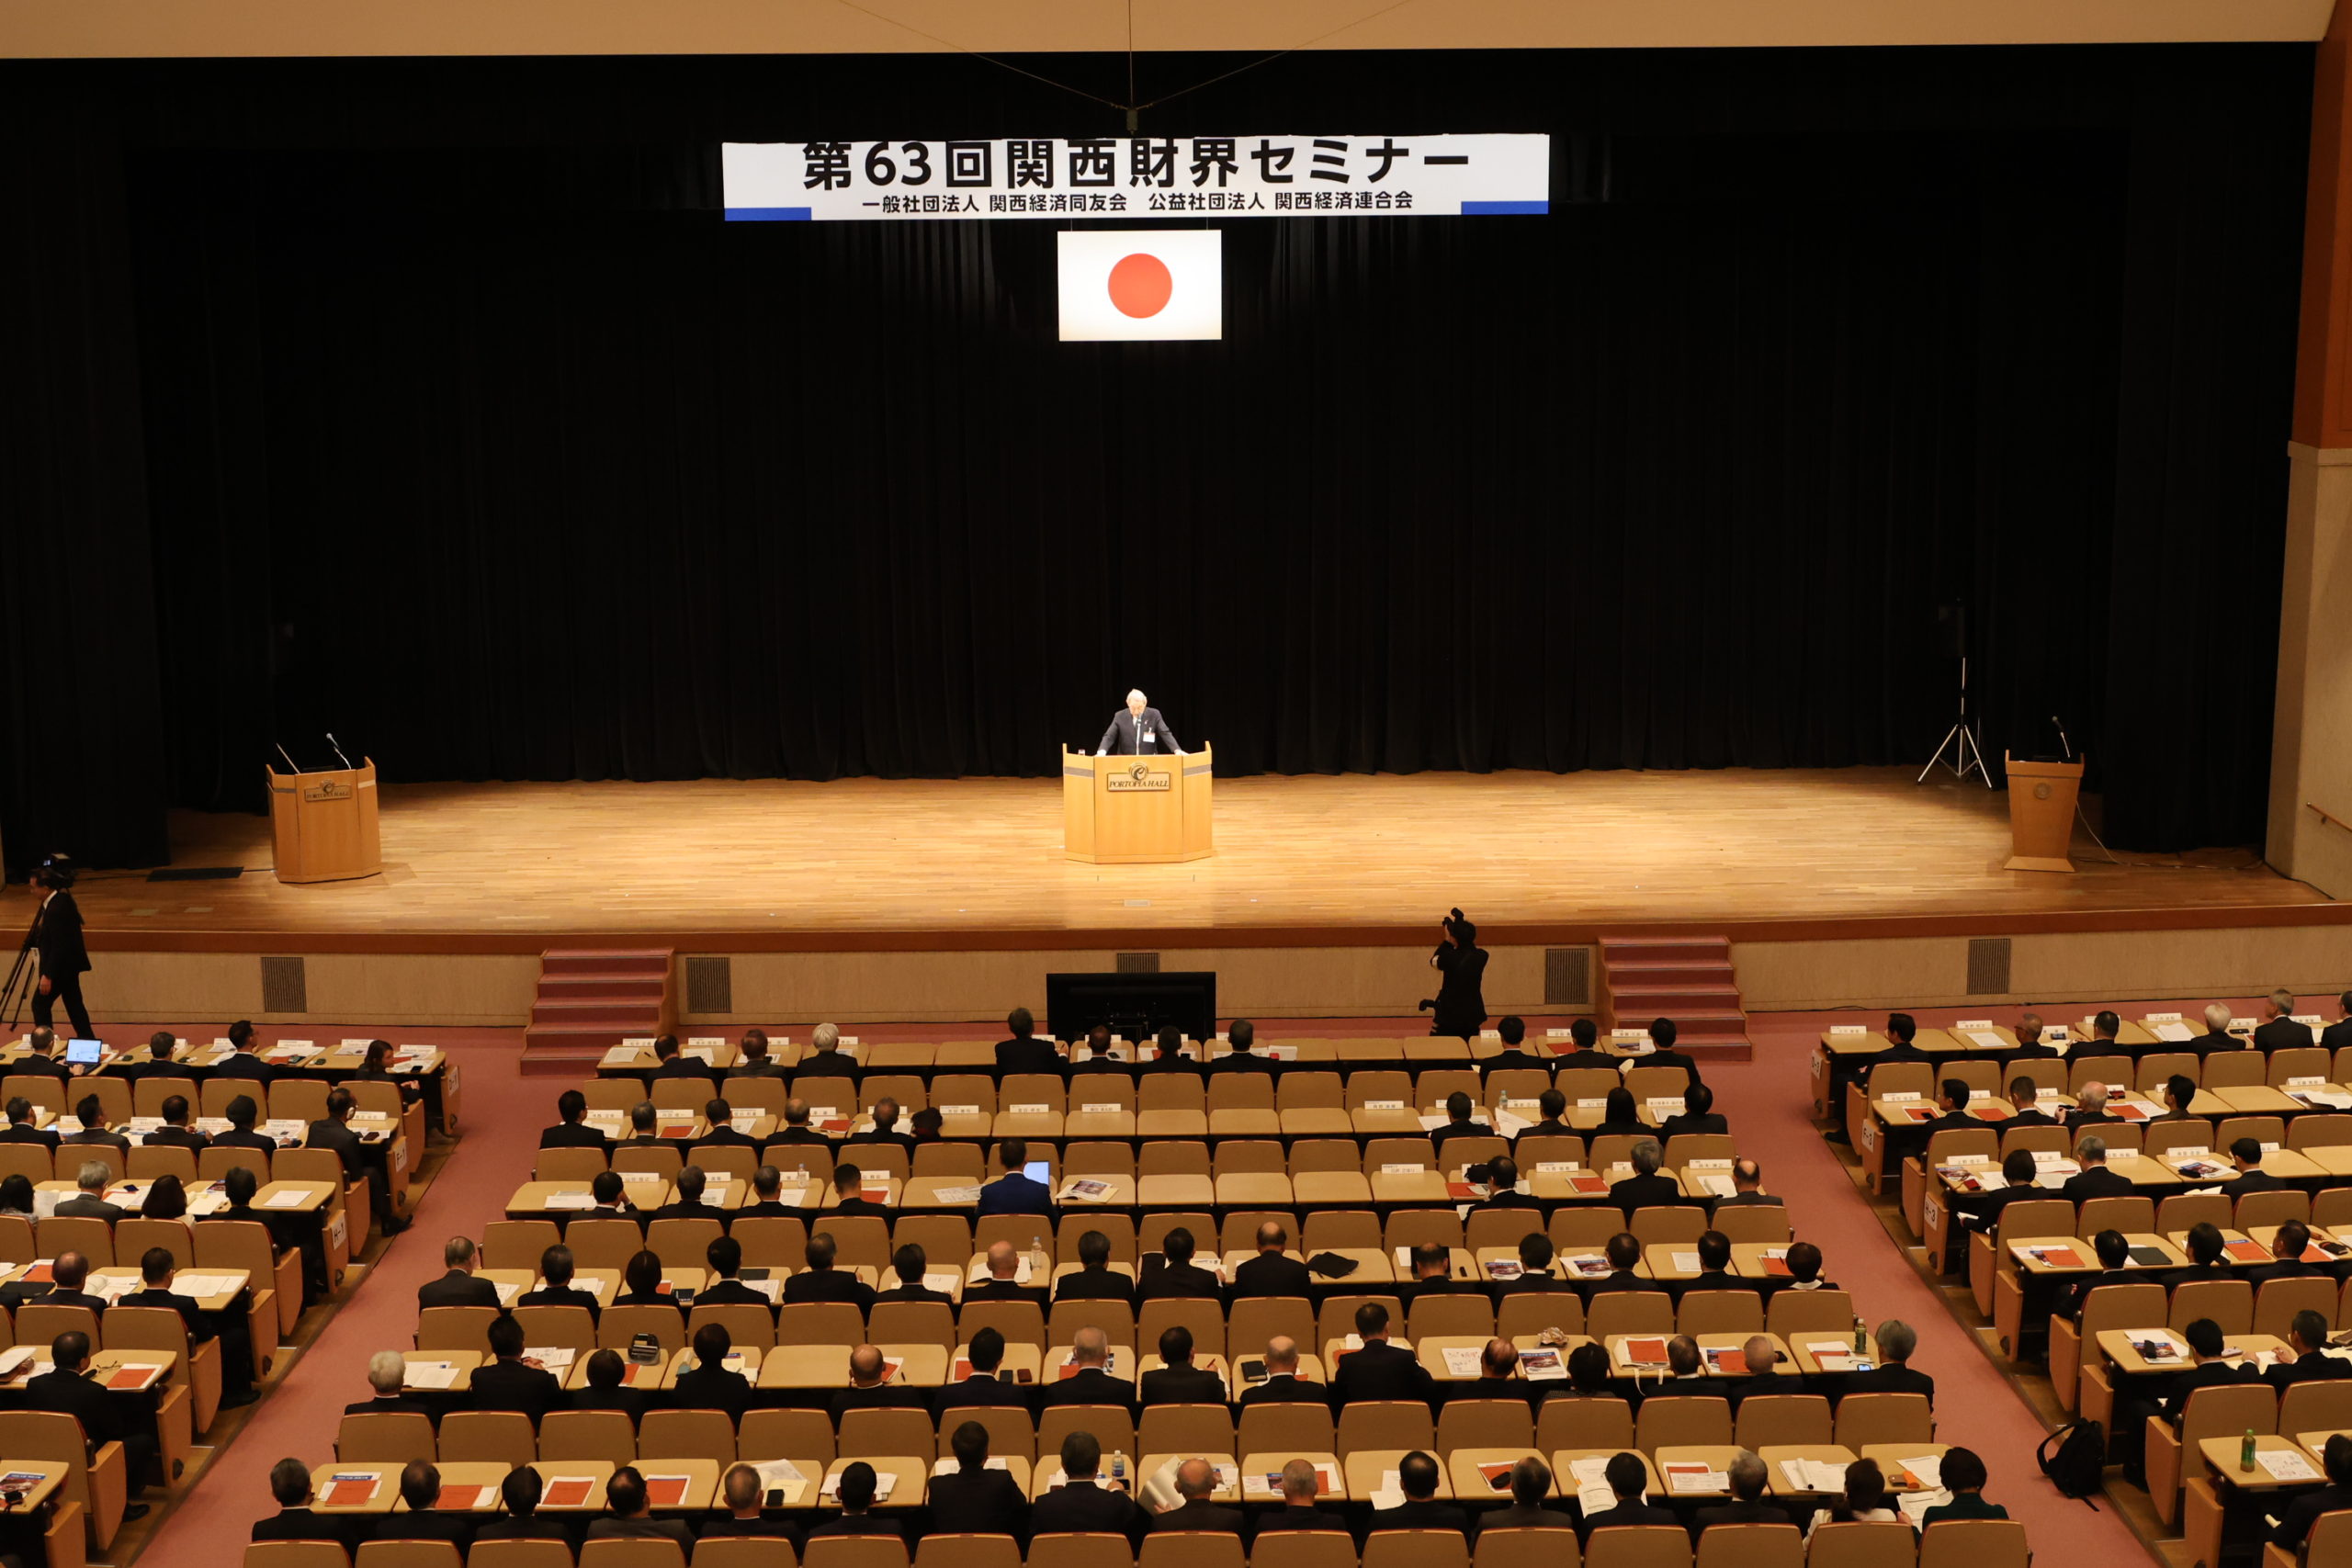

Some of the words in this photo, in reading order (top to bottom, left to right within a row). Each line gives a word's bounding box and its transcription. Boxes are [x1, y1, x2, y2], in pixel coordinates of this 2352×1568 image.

[803, 138, 1469, 190] 第63回関西財界セミナー
[862, 194, 979, 214] 一般社団法人
[989, 193, 1127, 212] 関西経済同友会
[1148, 191, 1265, 211] 公益社団法人
[1274, 190, 1413, 209] 関西経済連合会
[1109, 780, 1147, 788] PORTOPIA
[1148, 779, 1169, 787] HALL
